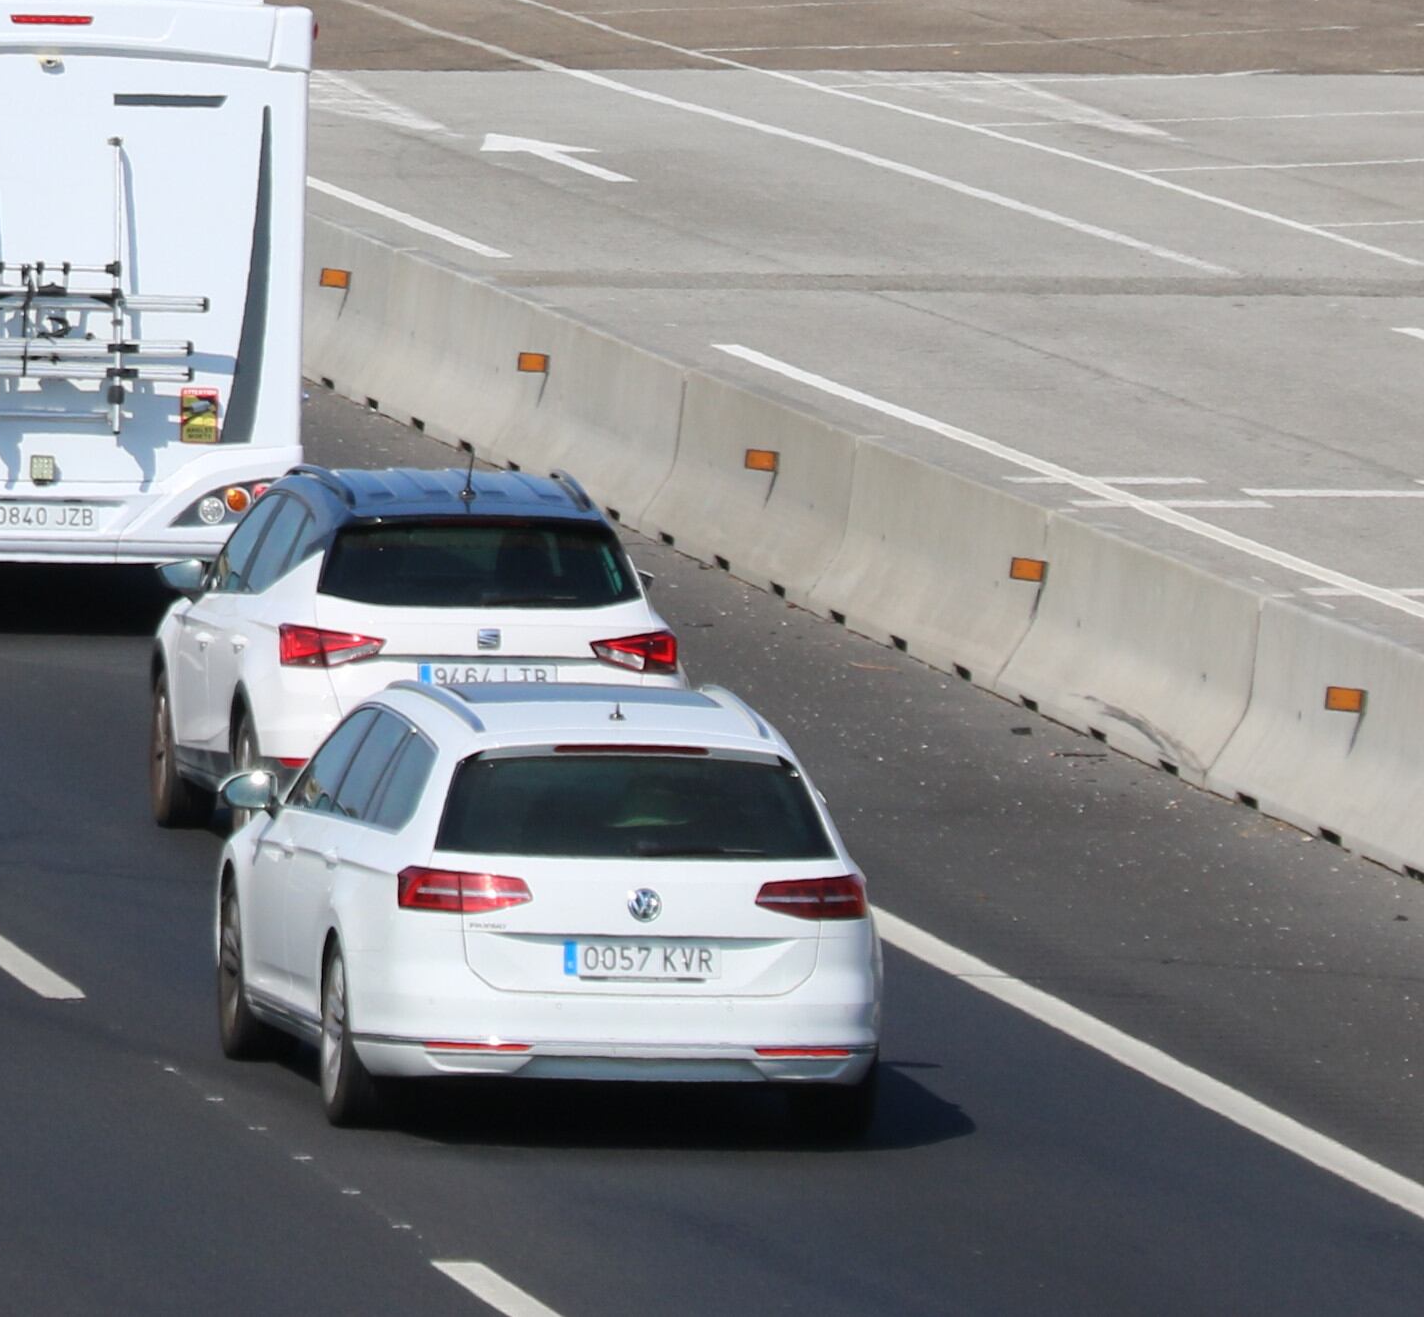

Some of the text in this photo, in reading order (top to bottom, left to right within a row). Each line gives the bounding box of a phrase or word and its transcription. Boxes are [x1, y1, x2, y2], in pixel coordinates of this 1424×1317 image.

[55, 507, 94, 526] JZB
[584, 946, 713, 972] 0057 KVR
